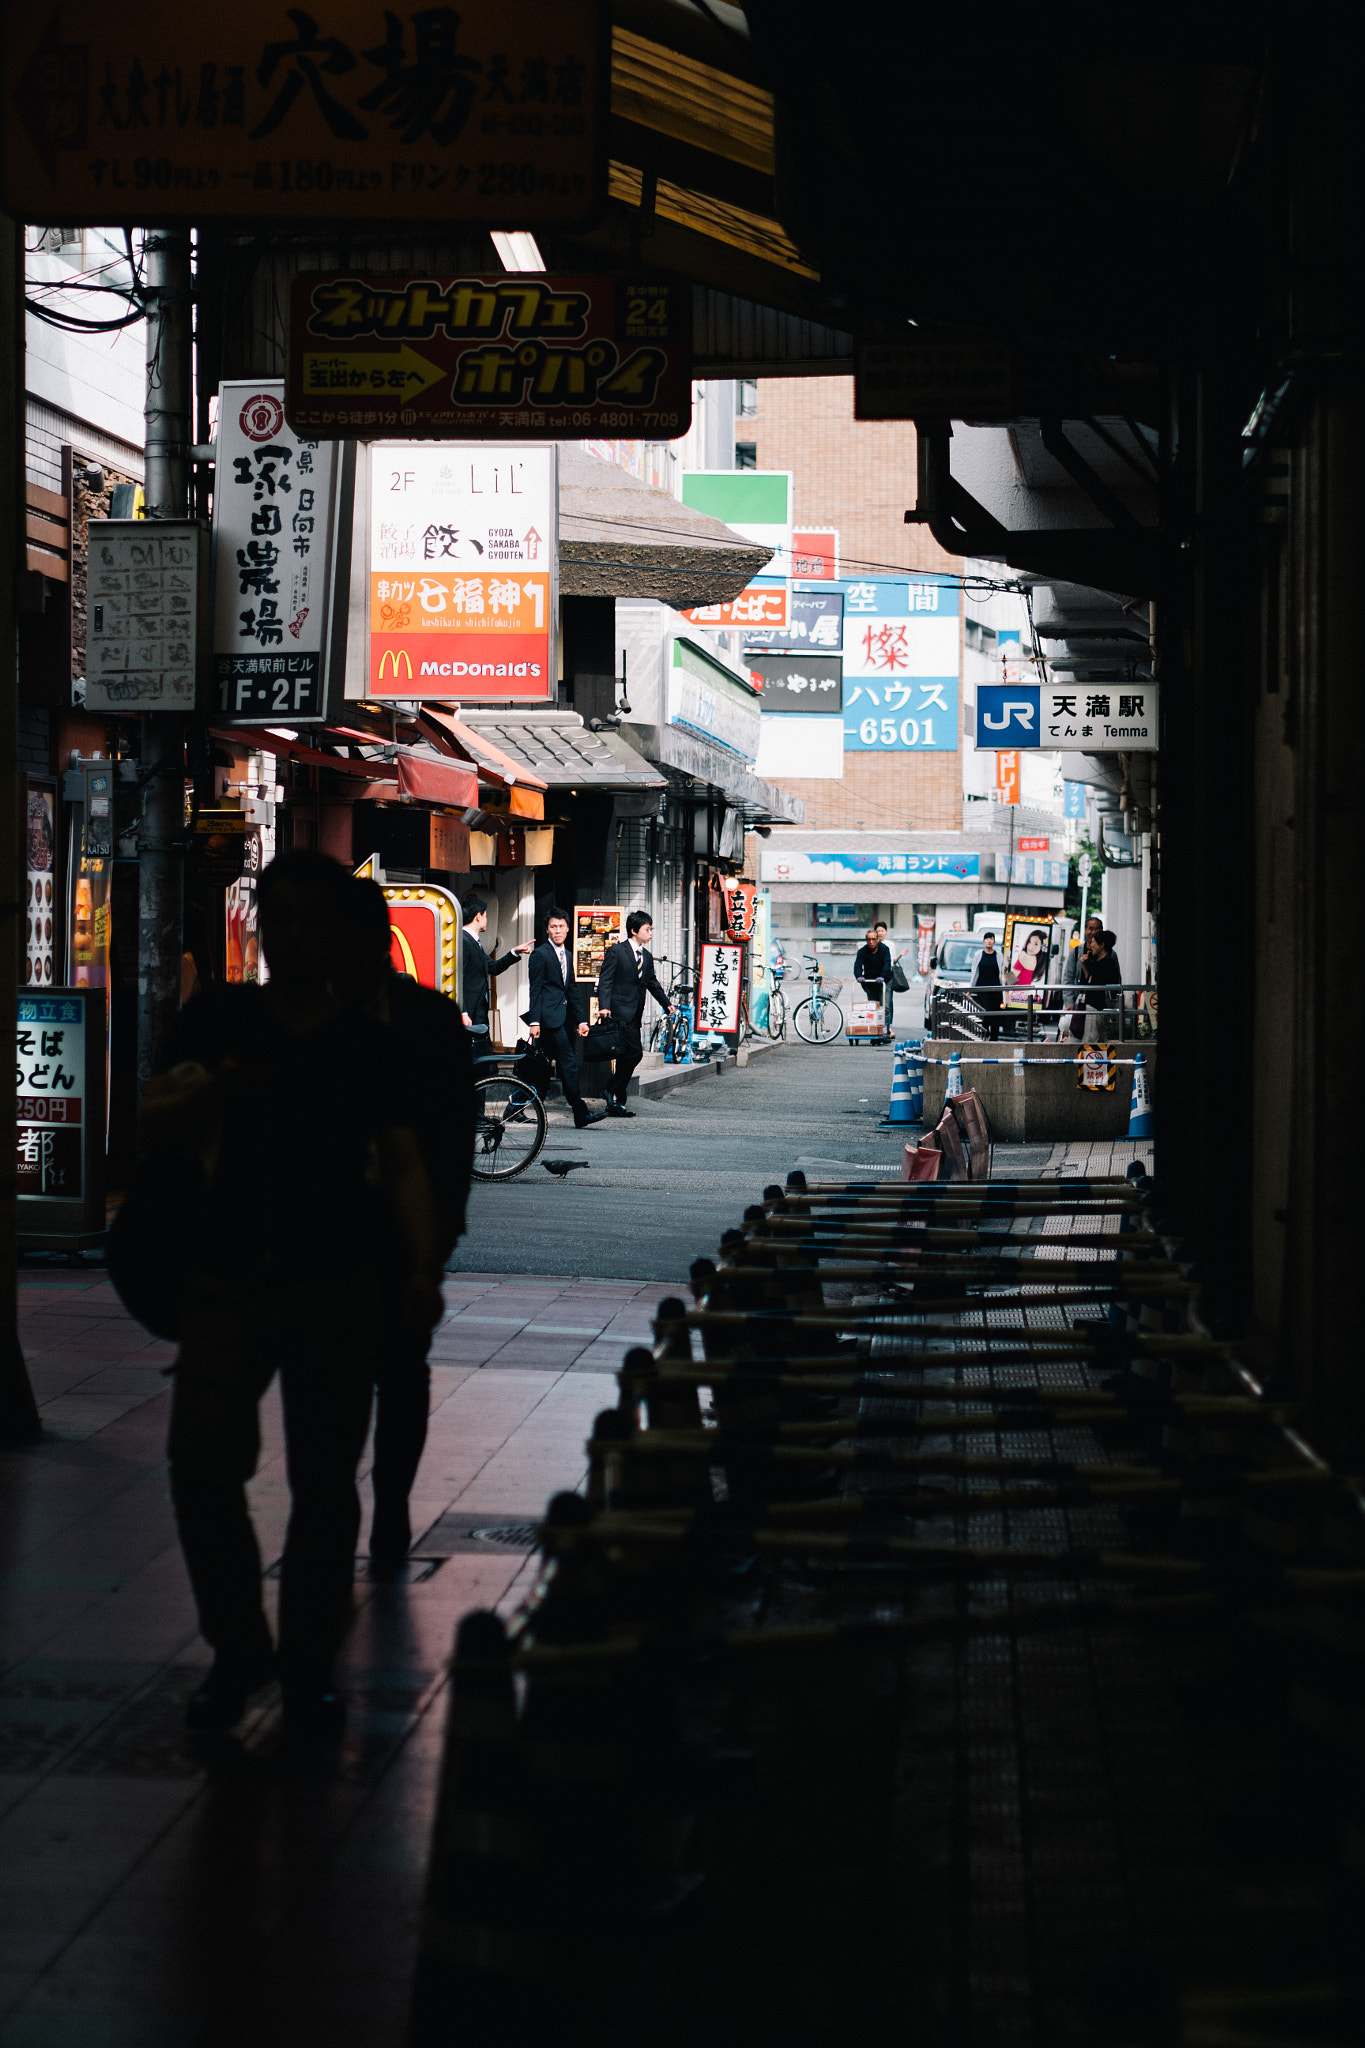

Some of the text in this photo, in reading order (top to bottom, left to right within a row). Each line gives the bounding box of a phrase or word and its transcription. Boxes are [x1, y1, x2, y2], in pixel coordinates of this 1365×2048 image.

[249, 8, 481, 146] 穴場
[484, 53, 586, 106] 天満店
[317, 286, 580, 328] ネットカフェ
[626, 299, 667, 325] 24
[310, 358, 348, 368] スーパー
[460, 345, 656, 394] ポパイ
[309, 370, 426, 388] 玉出から左へ
[295, 411, 398, 426] ここから徒歩1分
[499, 411, 546, 427] 天満店
[390, 471, 416, 491] 2F
[293, 488, 316, 558] 日向市
[488, 528, 514, 537] GYOZA
[232, 444, 294, 647] 塚田農場
[488, 540, 520, 549] SAKABA
[488, 551, 524, 560] GYOUTEN
[377, 577, 521, 614] 串カツ 七福神
[421, 617, 461, 628] kushikatu
[420, 661, 541, 677] McDonald's
[845, 681, 949, 712] ハウス
[1052, 694, 1145, 718] 天満駅
[983, 702, 1035, 730] JR
[1048, 724, 1148, 737] てんま Temma
[877, 855, 949, 871] 洗濯ランド
[17, 1031, 64, 1057] そば
